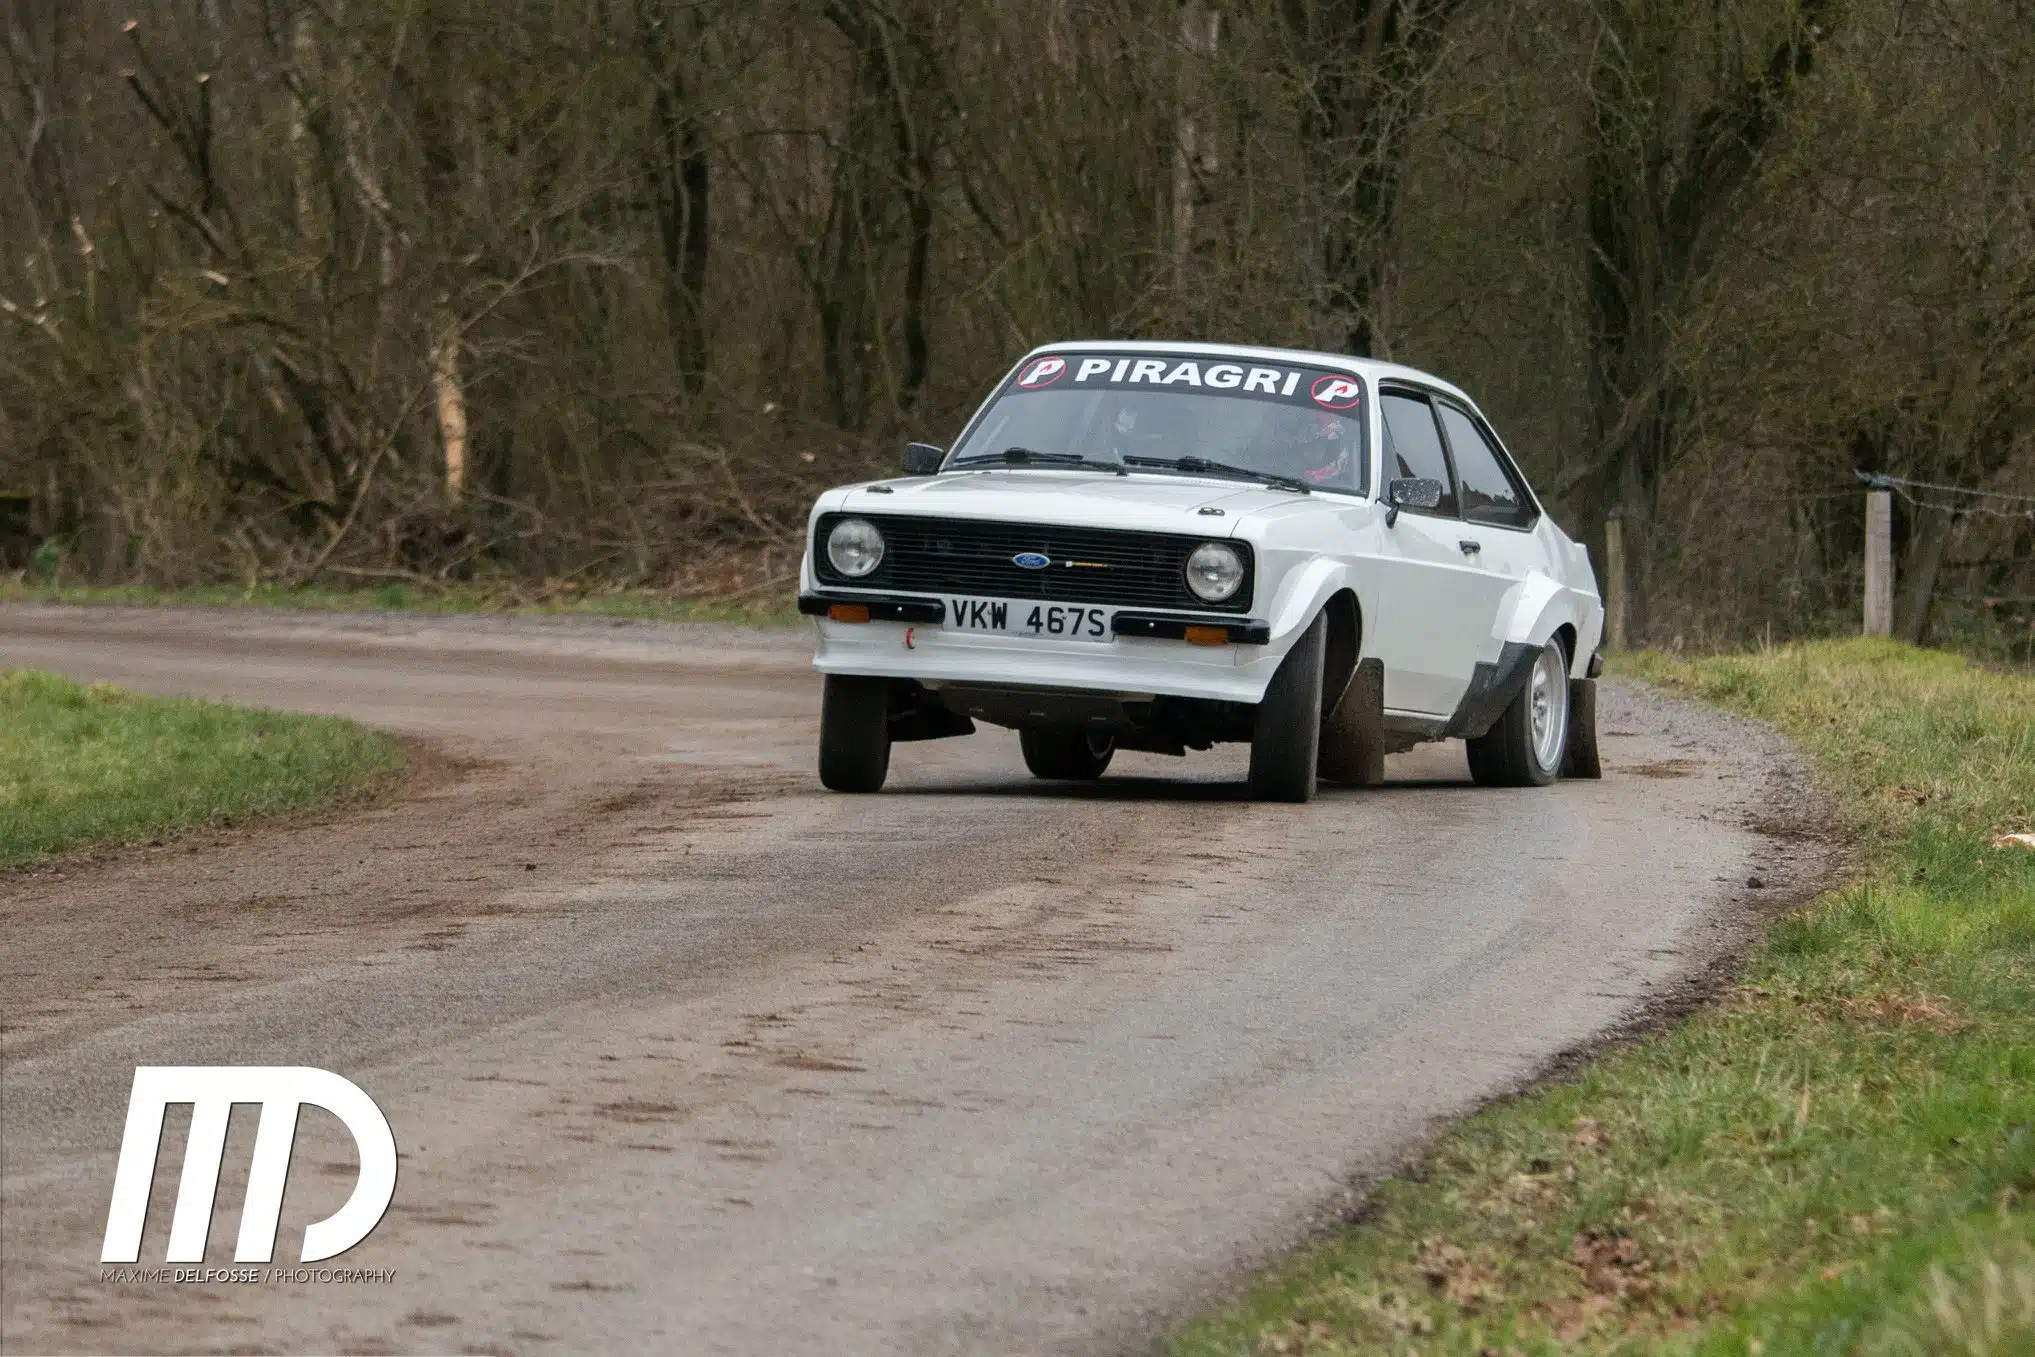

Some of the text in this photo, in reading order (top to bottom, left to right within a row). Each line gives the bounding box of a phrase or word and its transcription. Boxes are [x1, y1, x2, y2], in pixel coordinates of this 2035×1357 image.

[1075, 358, 1301, 396] PIRAGRI
[952, 599, 1105, 637] VKW 467S
